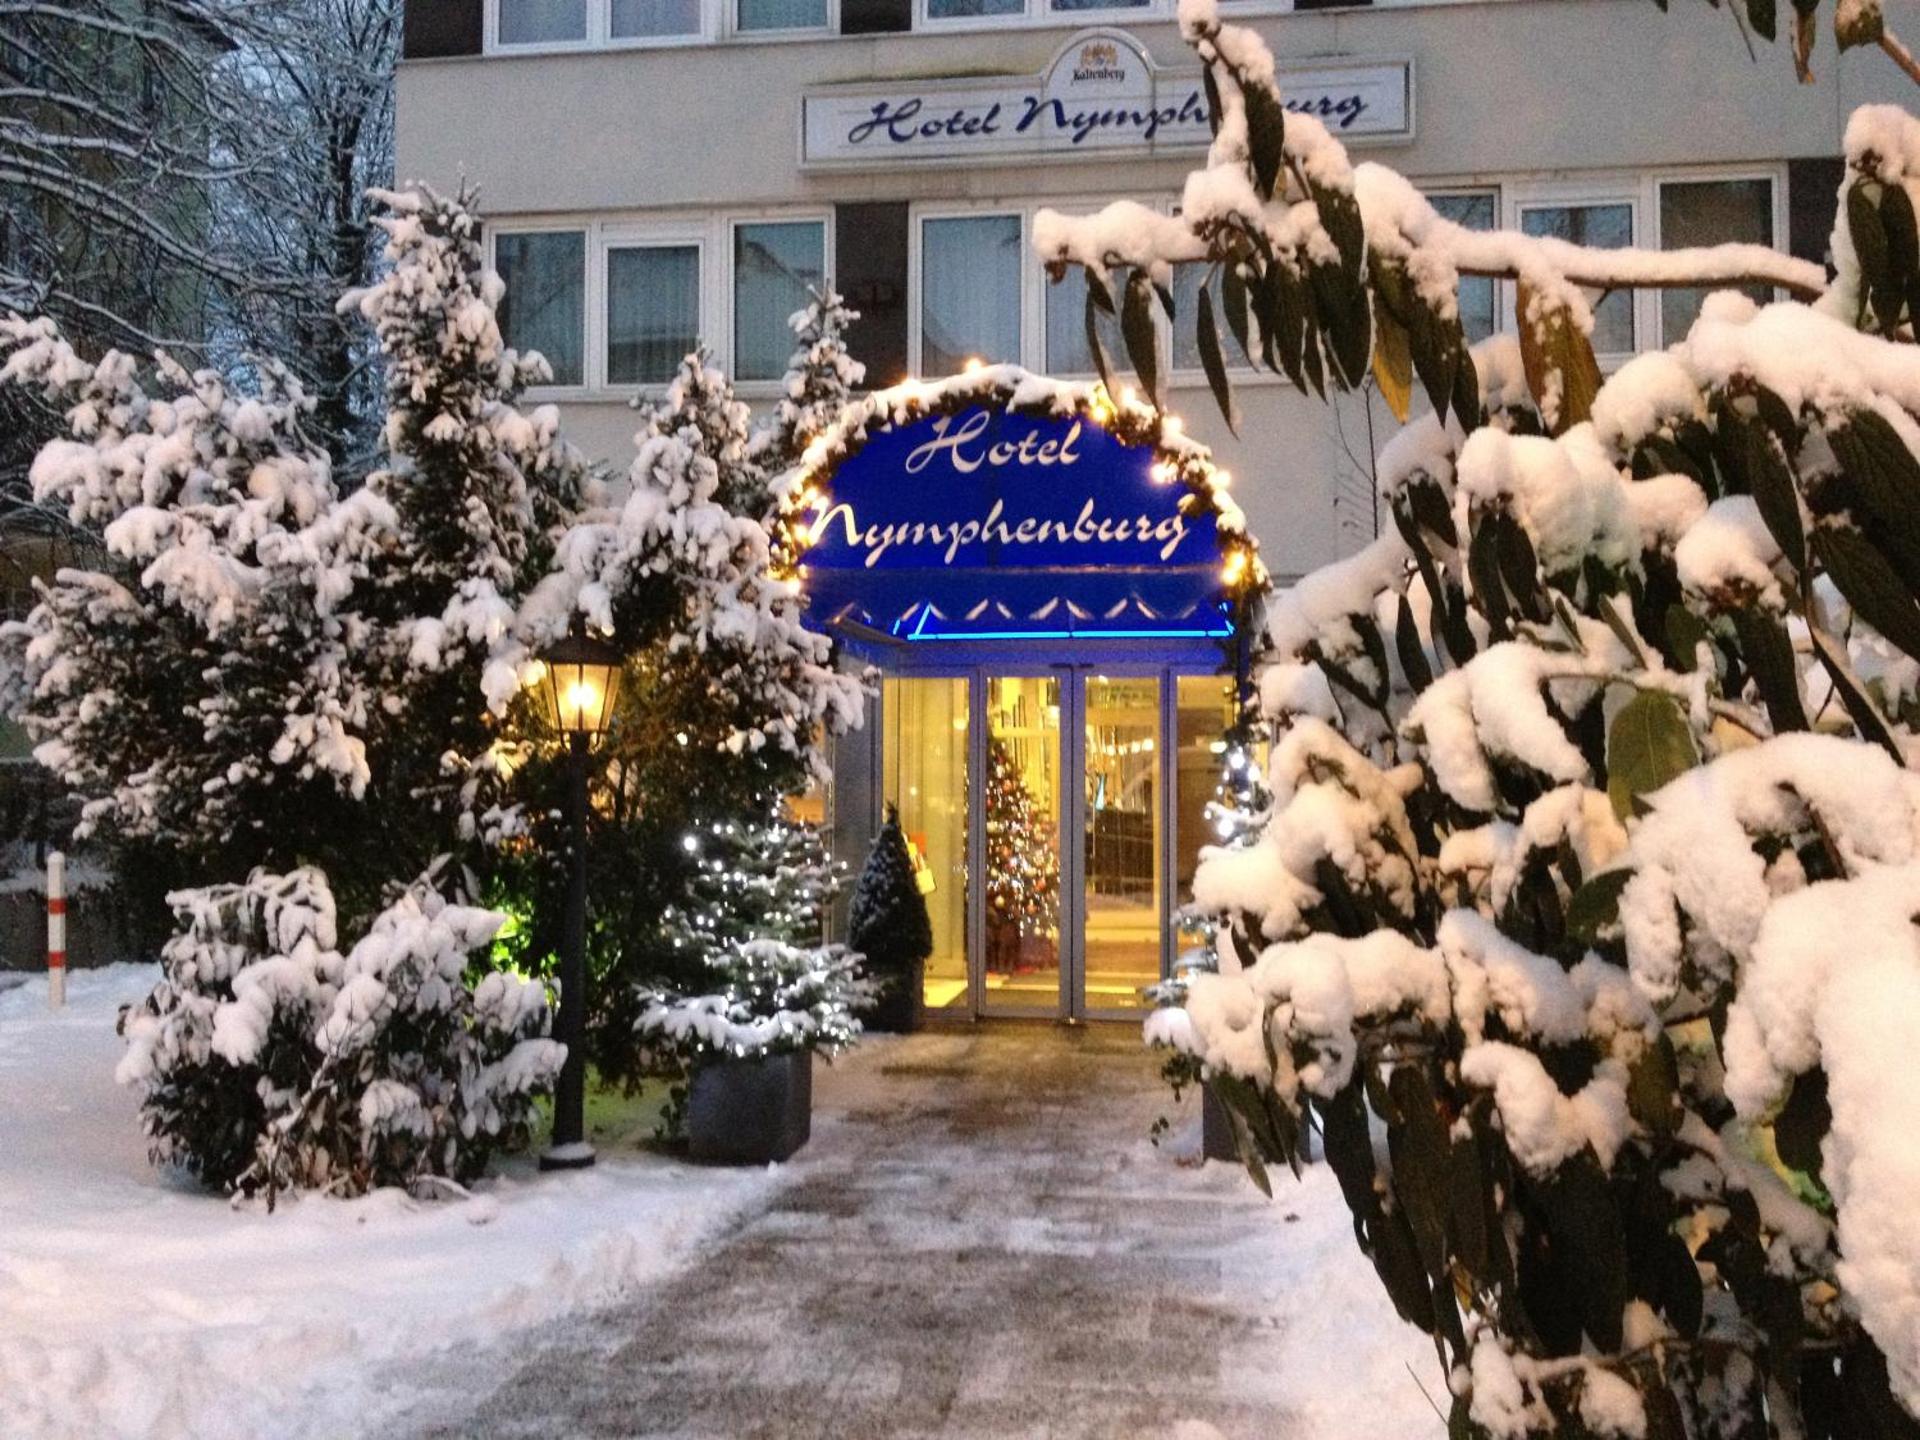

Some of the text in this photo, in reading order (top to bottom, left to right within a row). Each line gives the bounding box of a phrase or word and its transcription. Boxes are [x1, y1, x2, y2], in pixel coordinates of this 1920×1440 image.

[1070, 67, 1125, 86] Kaltenberg
[848, 91, 1368, 144] Hotel Nymphurg
[906, 410, 1081, 474] Hotel
[808, 496, 1190, 568] Nymphenburg
